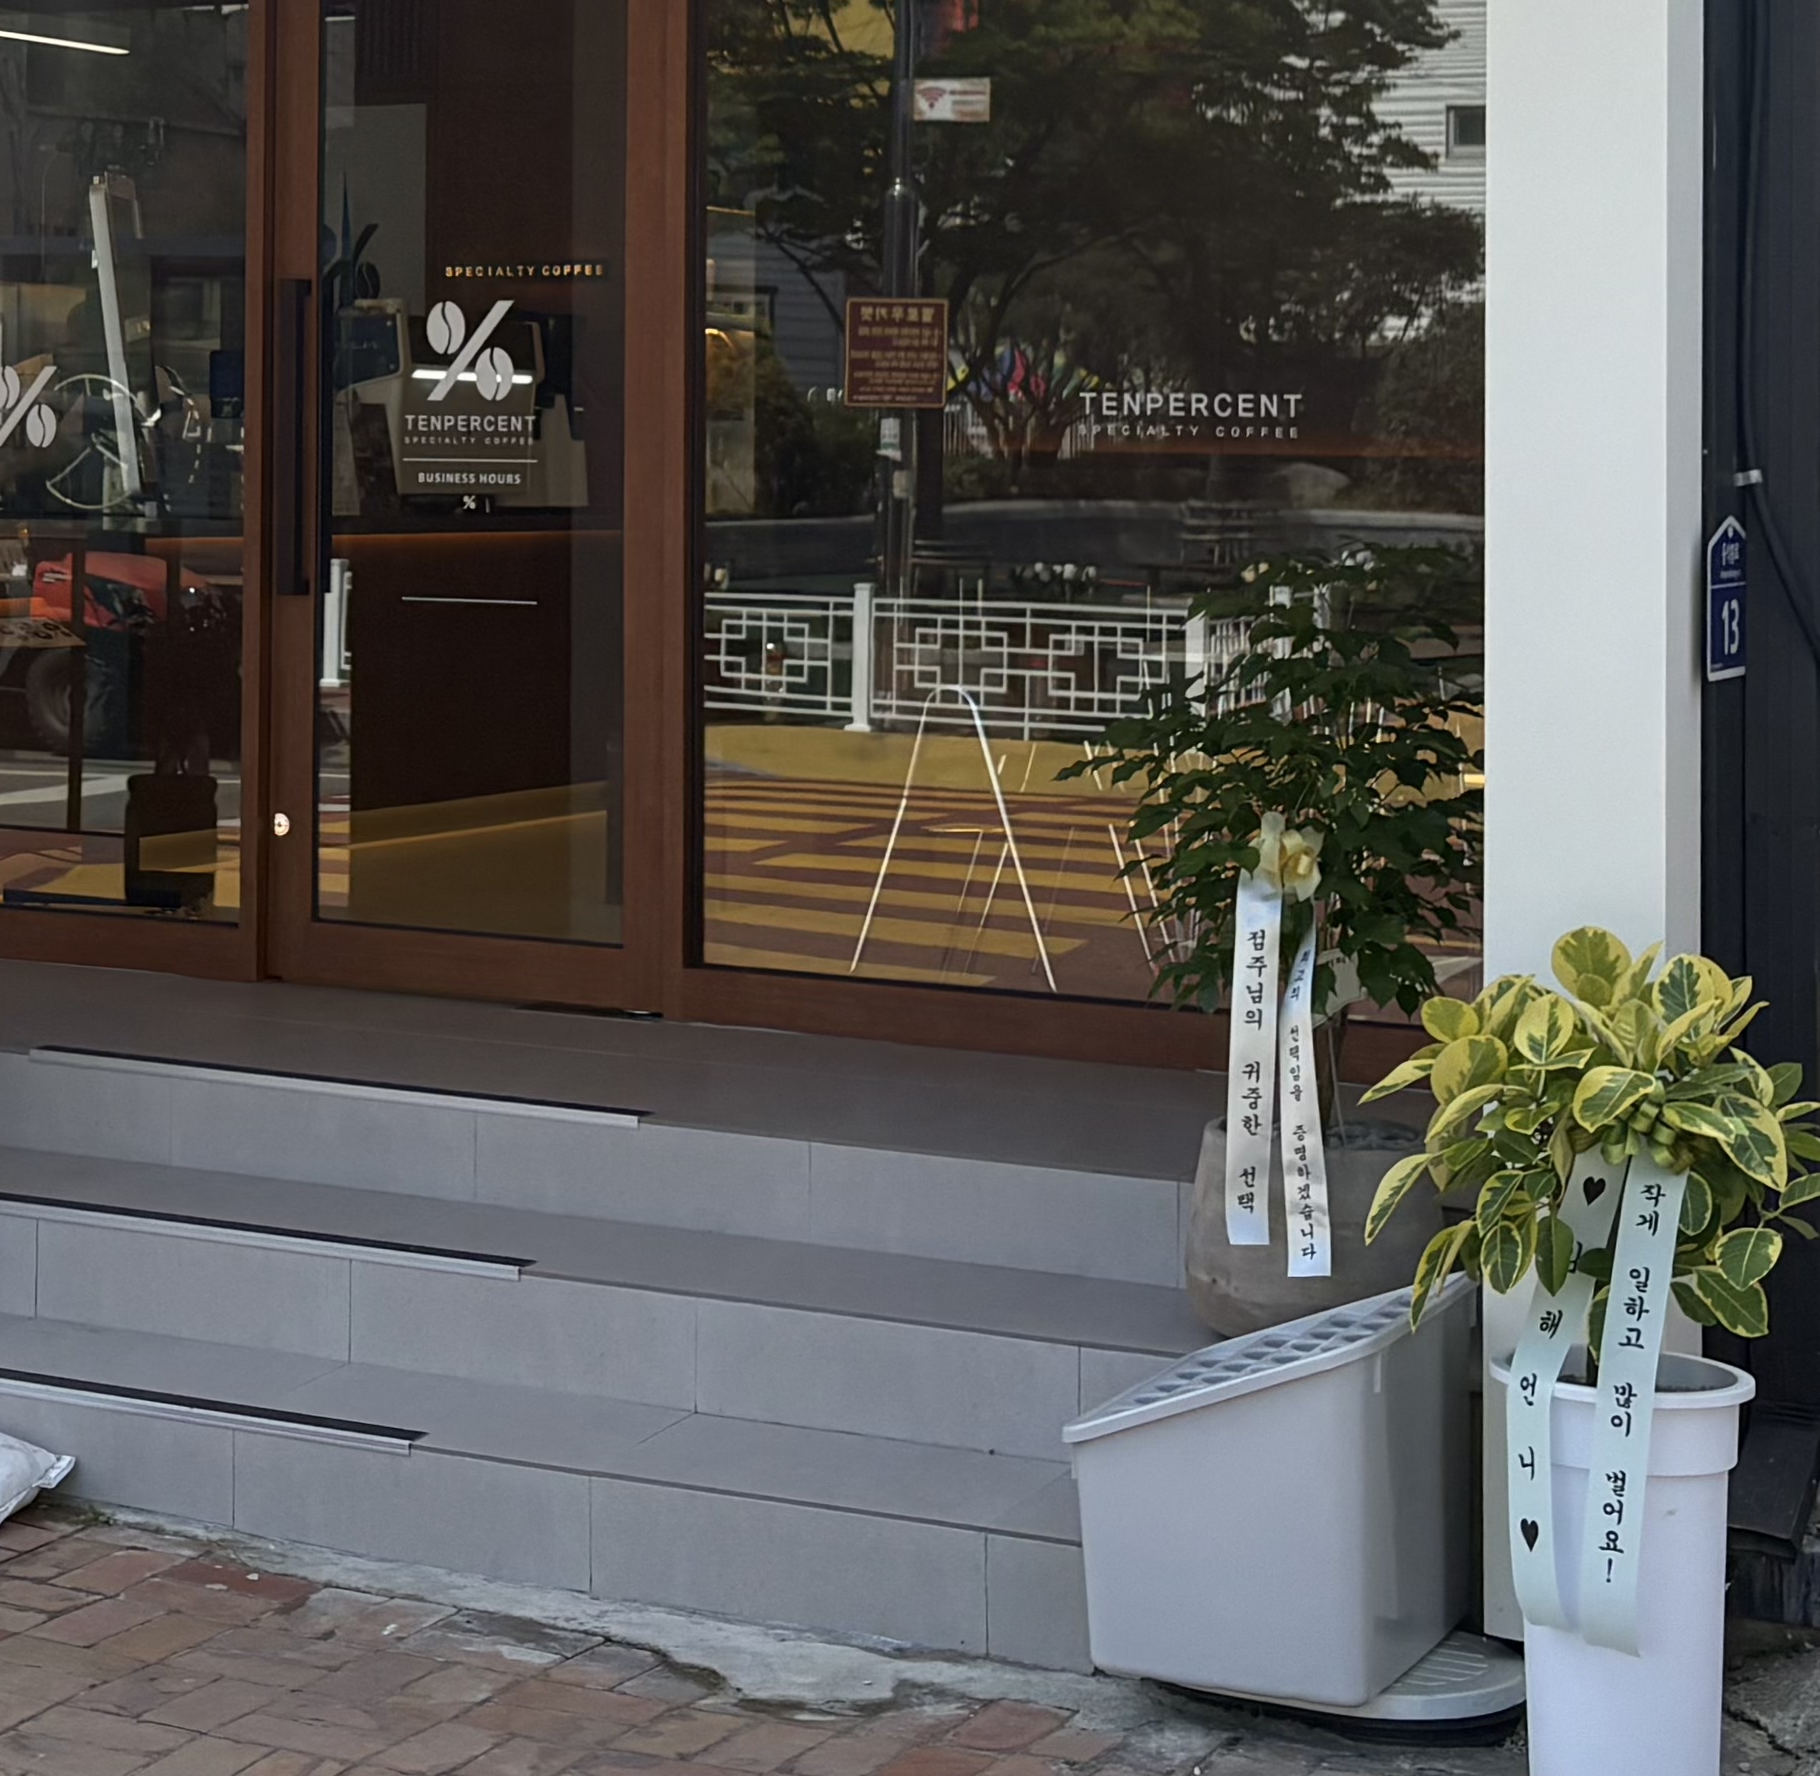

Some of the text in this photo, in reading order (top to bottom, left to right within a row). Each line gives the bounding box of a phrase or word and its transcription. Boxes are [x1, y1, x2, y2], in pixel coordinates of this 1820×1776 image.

[445, 264, 604, 278] SPECIALTY COFFEE
[1079, 391, 1303, 418] TENPERCENT
[404, 414, 537, 432] TENPERCENT
[1078, 424, 1299, 439] SPECIALTY COFFEE
[404, 436, 535, 446] SPECIALTY COFFEE
[418, 472, 521, 485] BUSINESS HOURS
[1721, 598, 1740, 656] 13
[1236, 928, 1268, 1215] 점주님의 귀중한 선택
[1292, 1123, 1317, 1261] 증명하겠습니다
[1617, 1265, 1651, 1351] 일하고
[1609, 1381, 1638, 1438] 많이
